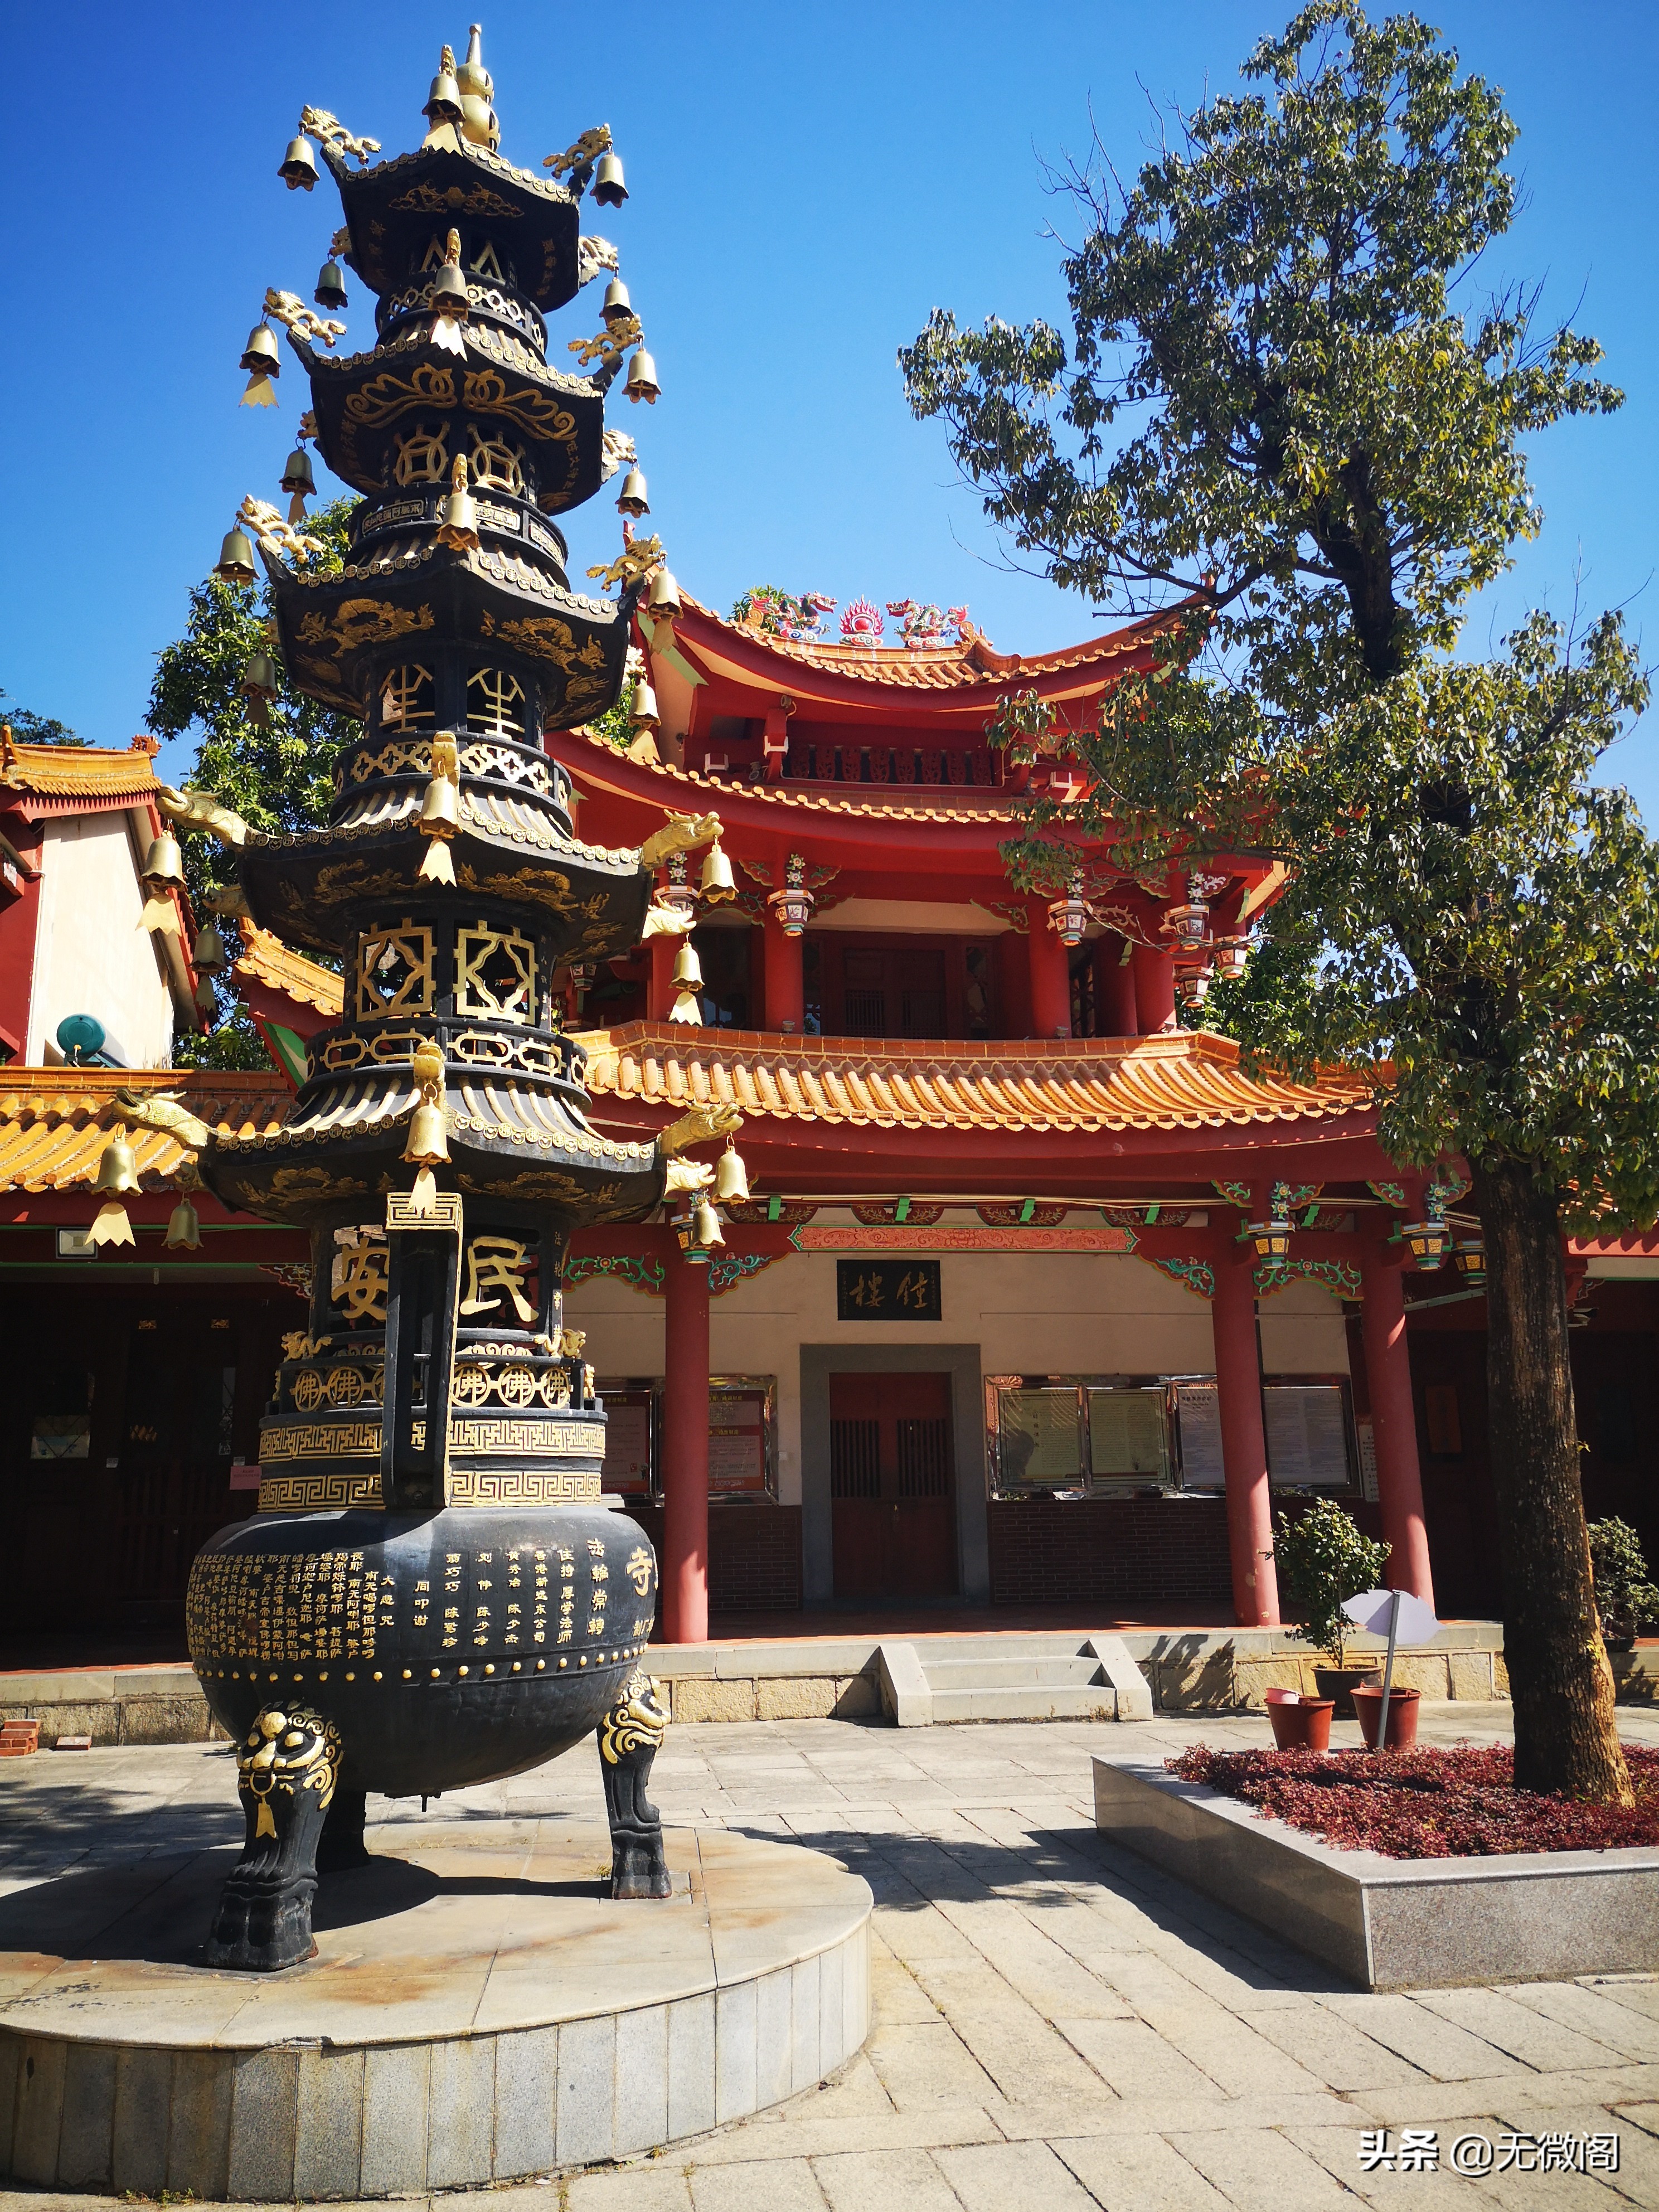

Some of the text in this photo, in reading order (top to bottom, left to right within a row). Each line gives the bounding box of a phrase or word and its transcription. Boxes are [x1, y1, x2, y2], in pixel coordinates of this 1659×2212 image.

[331, 1238, 390, 1321] 安
[460, 1236, 539, 1322] 民
[298, 1371, 359, 1409] 佛 佛
[453, 1369, 566, 1406] 佛 佛 佛
[379, 1575, 395, 1626] 大悲咒
[413, 1580, 430, 1626] 同叩谢
